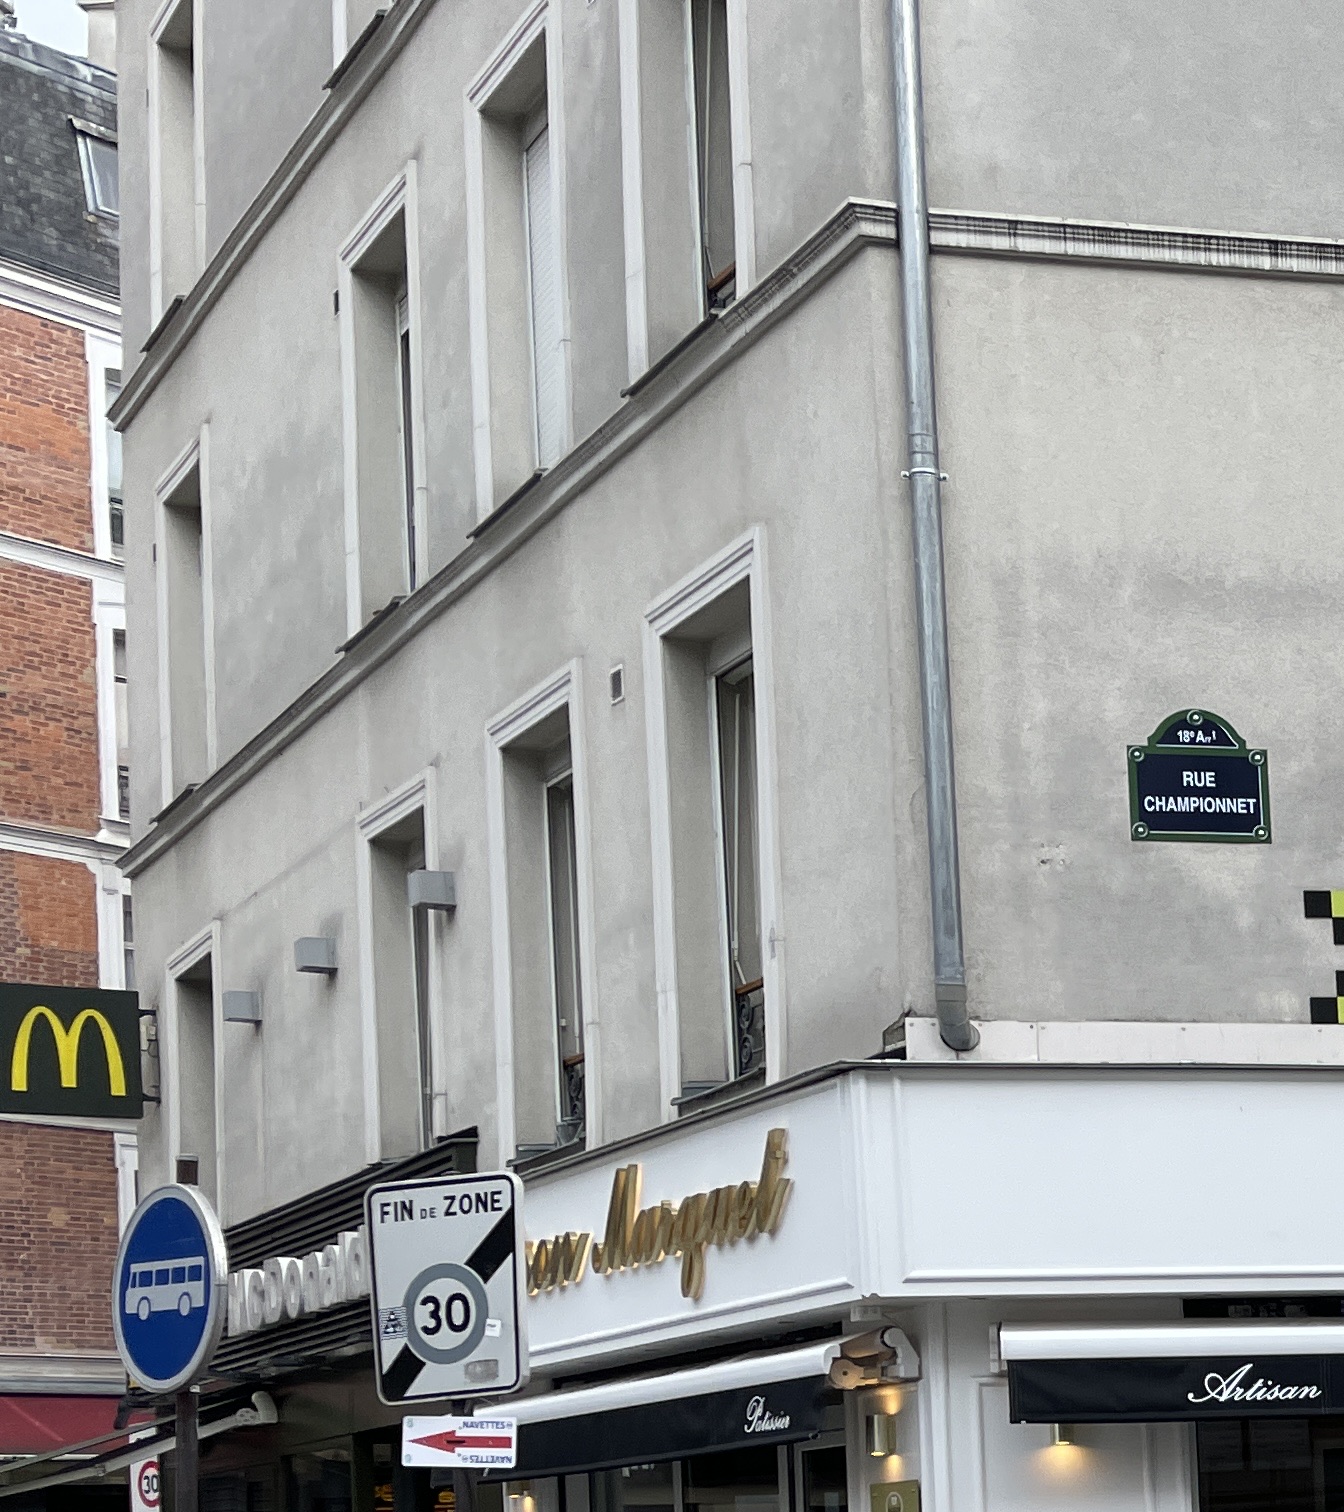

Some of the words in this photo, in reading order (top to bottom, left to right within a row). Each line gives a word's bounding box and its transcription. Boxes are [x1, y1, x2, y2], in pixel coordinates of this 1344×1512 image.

[1182, 771, 1216, 788] RUE
[1143, 795, 1257, 814] CHAMPIONNET
[379, 1199, 414, 1224] FIN
[420, 1207, 437, 1220] DE
[443, 1190, 503, 1217] ZONE
[419, 1292, 471, 1336] 30
[1187, 1363, 1322, 1403] Artisan
[743, 1396, 791, 1433] Patissier
[462, 1420, 506, 1430] NAVETTES
[469, 1454, 513, 1464] NAVETTES
[143, 1474, 160, 1494] 30
